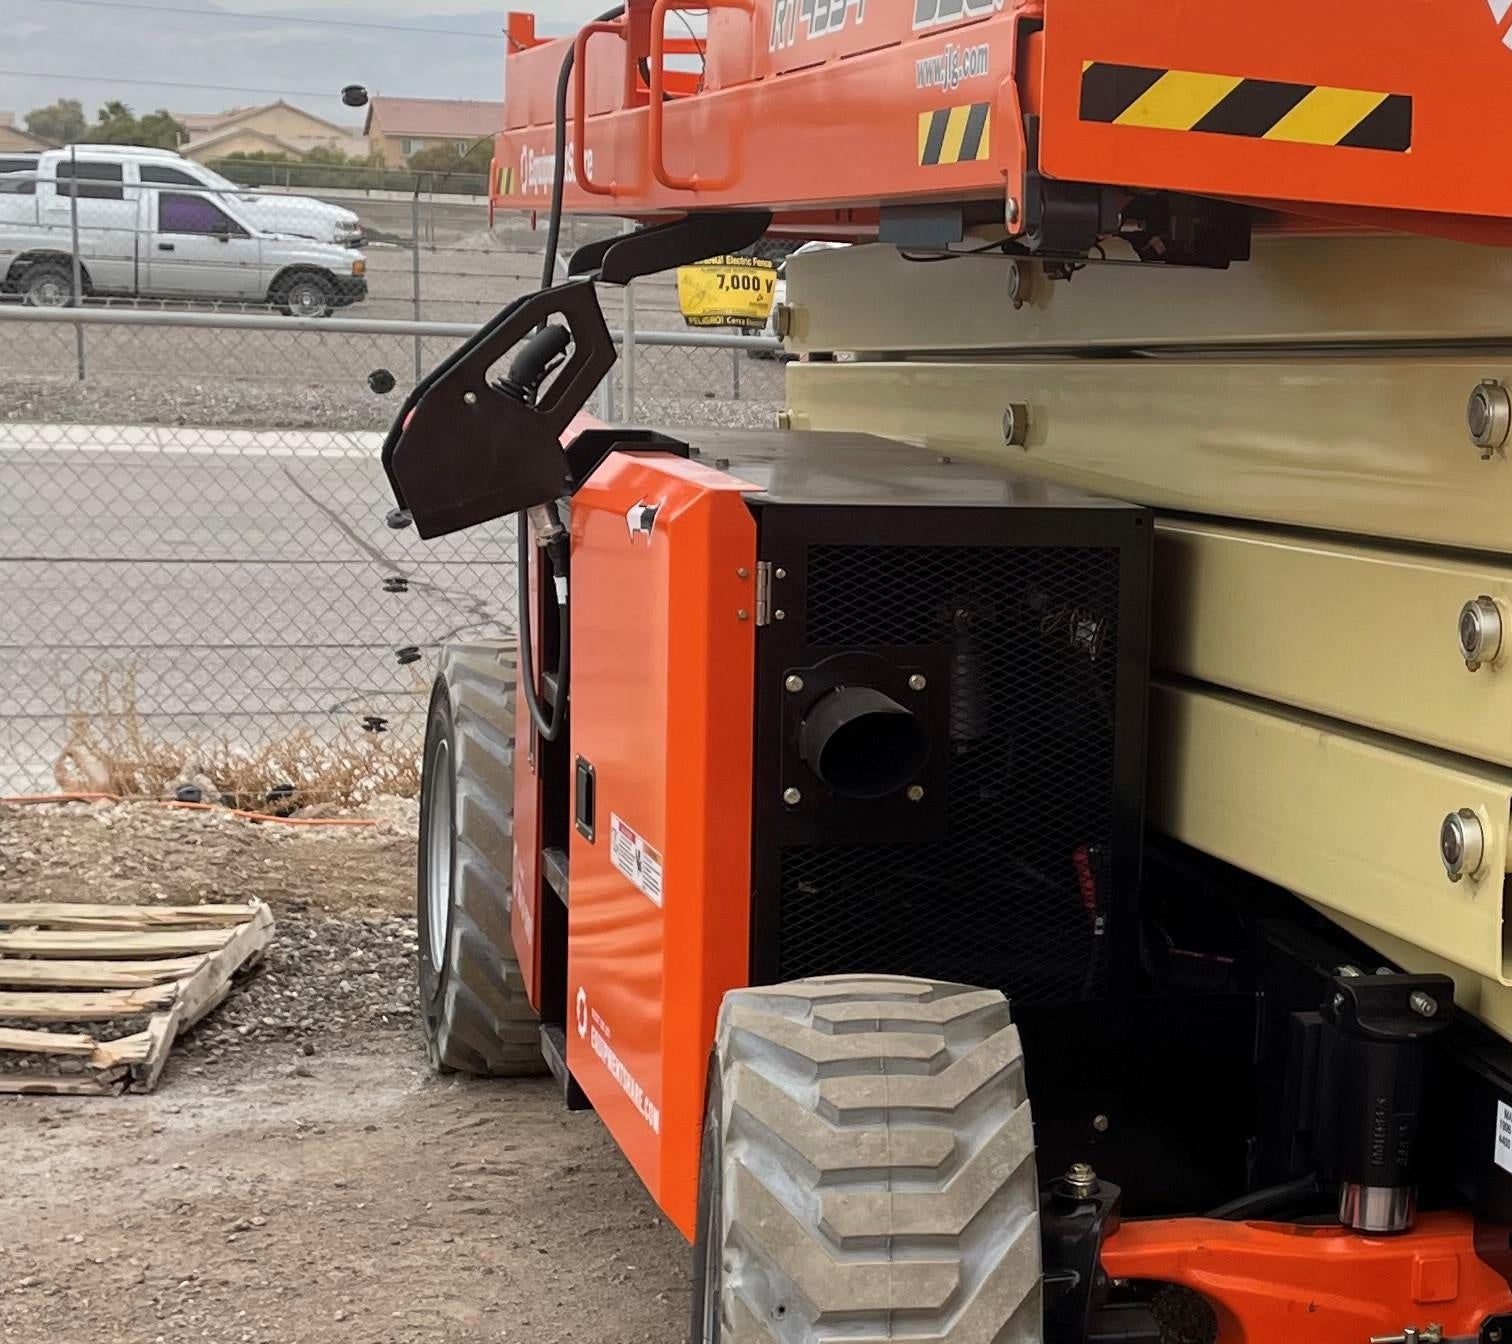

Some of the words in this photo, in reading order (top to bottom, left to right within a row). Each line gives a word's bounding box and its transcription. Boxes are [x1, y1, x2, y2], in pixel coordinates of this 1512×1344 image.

[916, 43, 989, 92] www.jlg.com
[716, 274, 761, 292] 7,000
[764, 278, 774, 294] V
